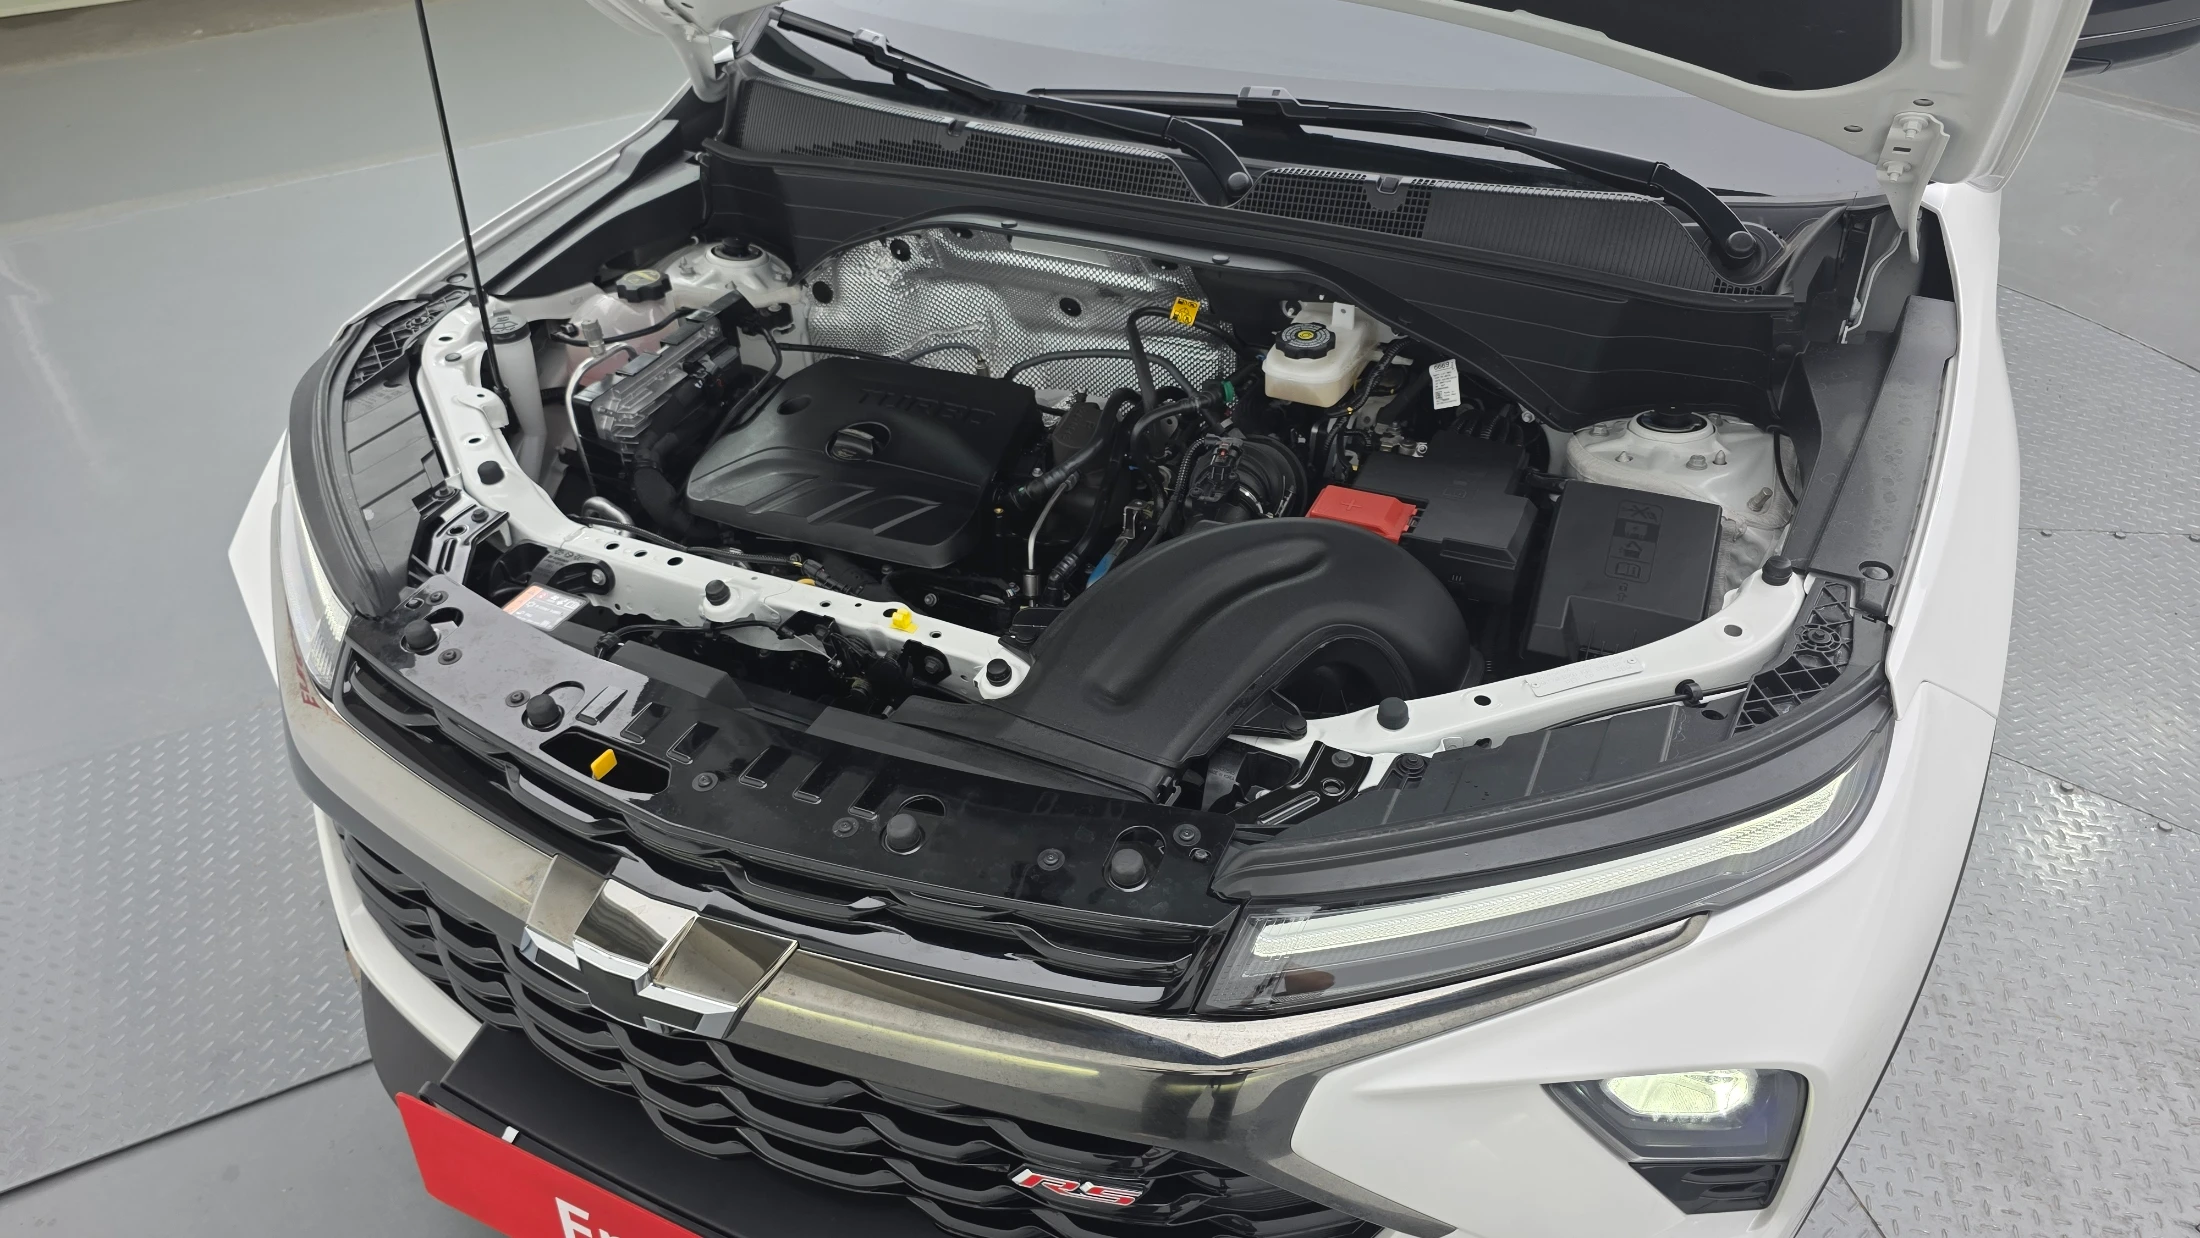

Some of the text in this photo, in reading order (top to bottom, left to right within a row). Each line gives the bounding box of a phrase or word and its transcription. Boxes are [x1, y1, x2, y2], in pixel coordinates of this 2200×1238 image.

[858, 388, 996, 425] TURBO
[1011, 1168, 1142, 1206] RS
[555, 1196, 619, 1238] E
